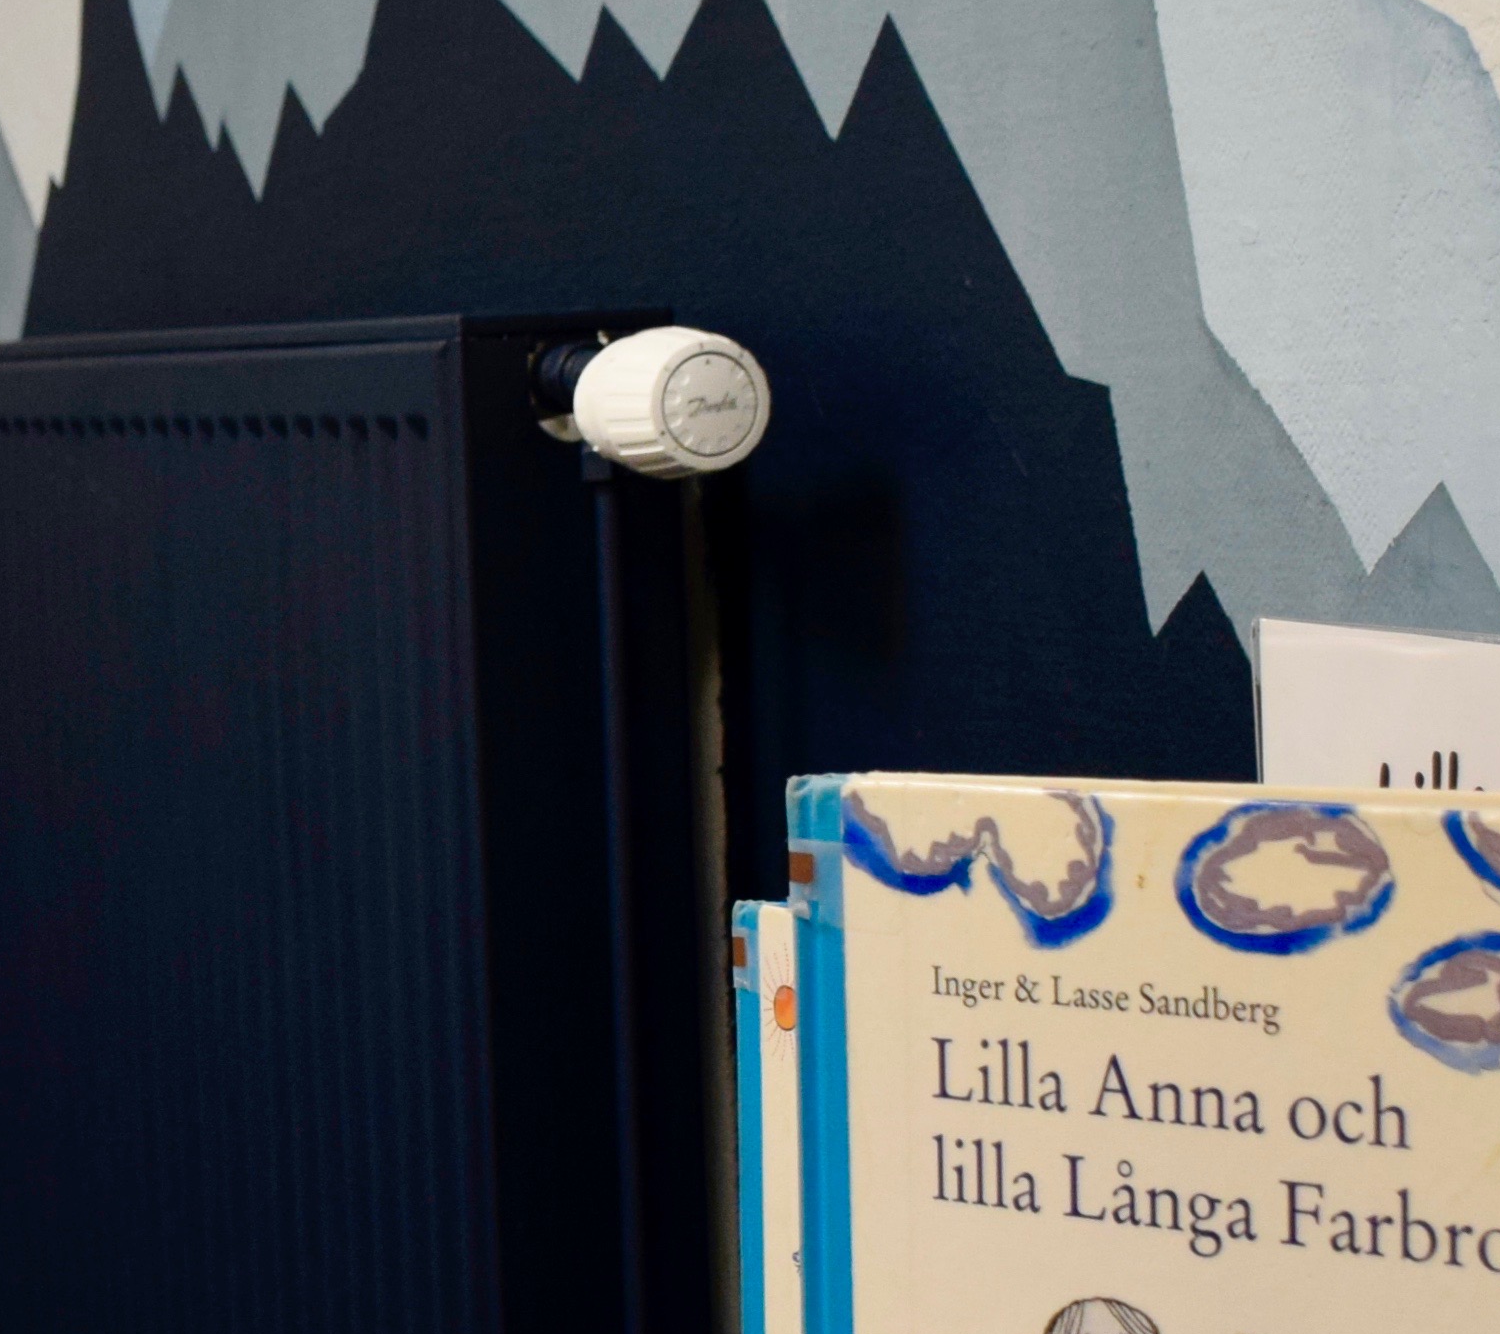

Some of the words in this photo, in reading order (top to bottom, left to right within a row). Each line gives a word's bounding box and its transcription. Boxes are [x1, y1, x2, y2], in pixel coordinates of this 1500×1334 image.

[931, 965, 1006, 1009] Inger
[1015, 974, 1041, 1005] &
[1051, 975, 1130, 1012] Lasse
[1139, 982, 1282, 1036] Sandberg
[931, 1036, 1068, 1113] Lilla
[1087, 1053, 1265, 1136] Anna
[1288, 1075, 1413, 1150] och
[932, 1133, 1041, 1214] lilla
[1063, 1153, 1258, 1258] Långa
